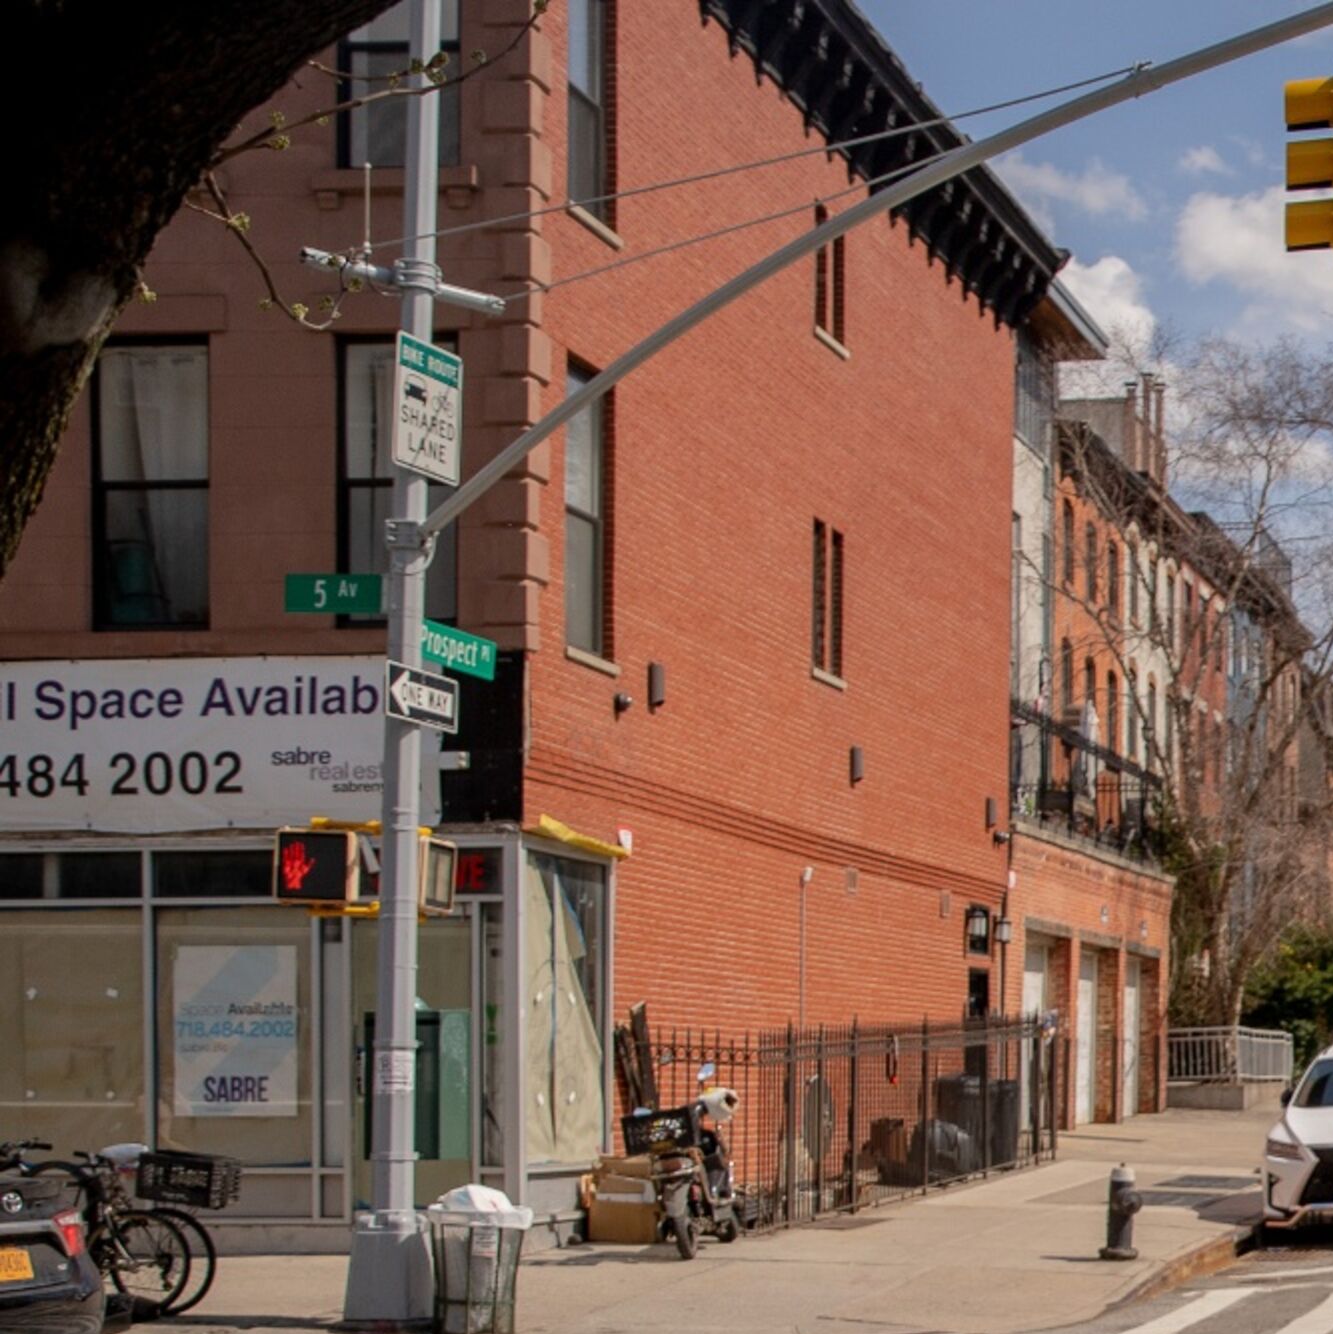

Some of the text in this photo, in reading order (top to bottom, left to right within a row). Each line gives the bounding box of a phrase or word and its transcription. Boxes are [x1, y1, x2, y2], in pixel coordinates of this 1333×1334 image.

[403, 345, 458, 380] BIKE ROUTE
[401, 404, 455, 441] SHARED
[408, 432, 447, 464] LANE
[313, 579, 358, 608] 5 Av
[420, 624, 479, 668] Prospect
[35, 680, 183, 729] Space
[200, 676, 386, 717] Availab
[401, 682, 448, 713] ONE WAY
[271, 746, 331, 765] sabre
[310, 762, 384, 780] real est
[0, 751, 244, 797] 484 2002
[227, 1001, 294, 1015] Available
[176, 1020, 294, 1038] 718.484.2002
[203, 1076, 269, 1102] SABRE
